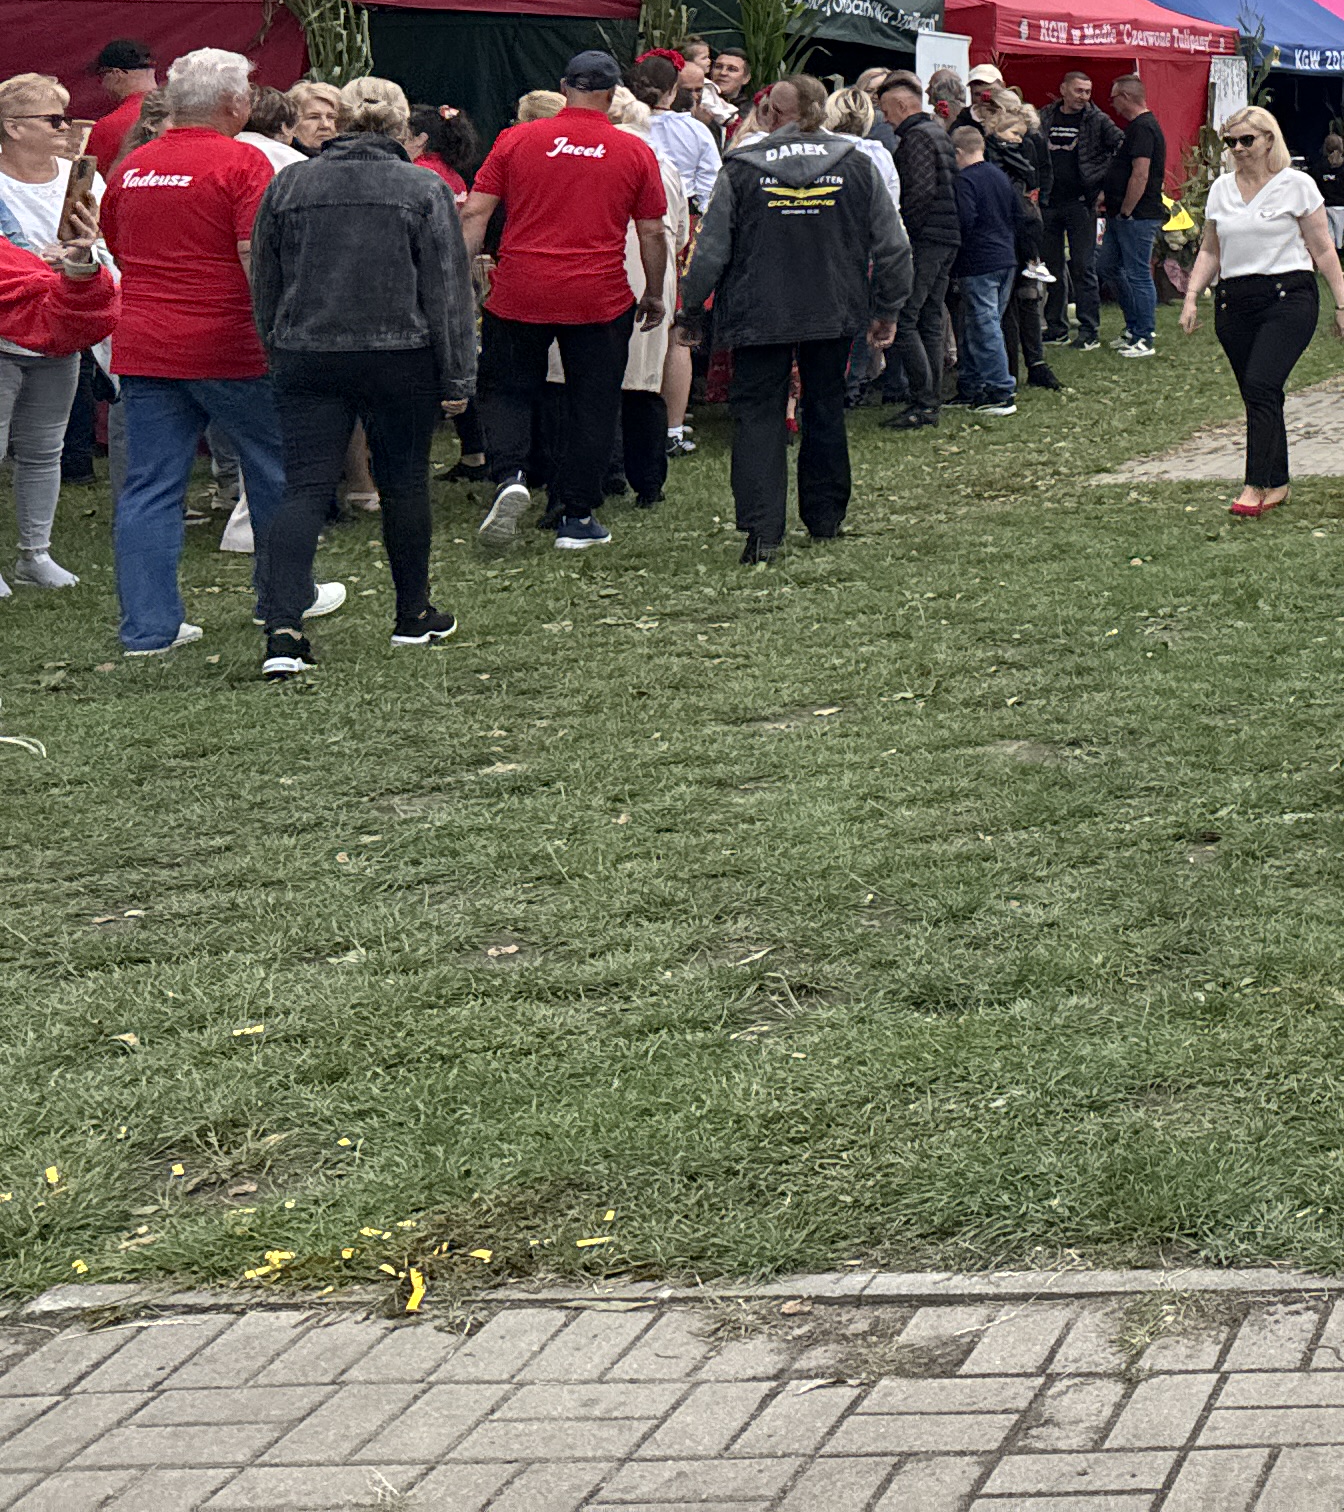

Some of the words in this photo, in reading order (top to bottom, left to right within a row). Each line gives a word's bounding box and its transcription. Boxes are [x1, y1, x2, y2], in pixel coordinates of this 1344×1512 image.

[1040, 20, 1068, 43] KGW
[1071, 29, 1081, 44] w
[1295, 49, 1320, 70] KGW
[546, 136, 606, 158] Jacek
[766, 143, 828, 161] DAREK
[122, 167, 193, 188] Tadeusz
[767, 199, 836, 207] GOLDWING
